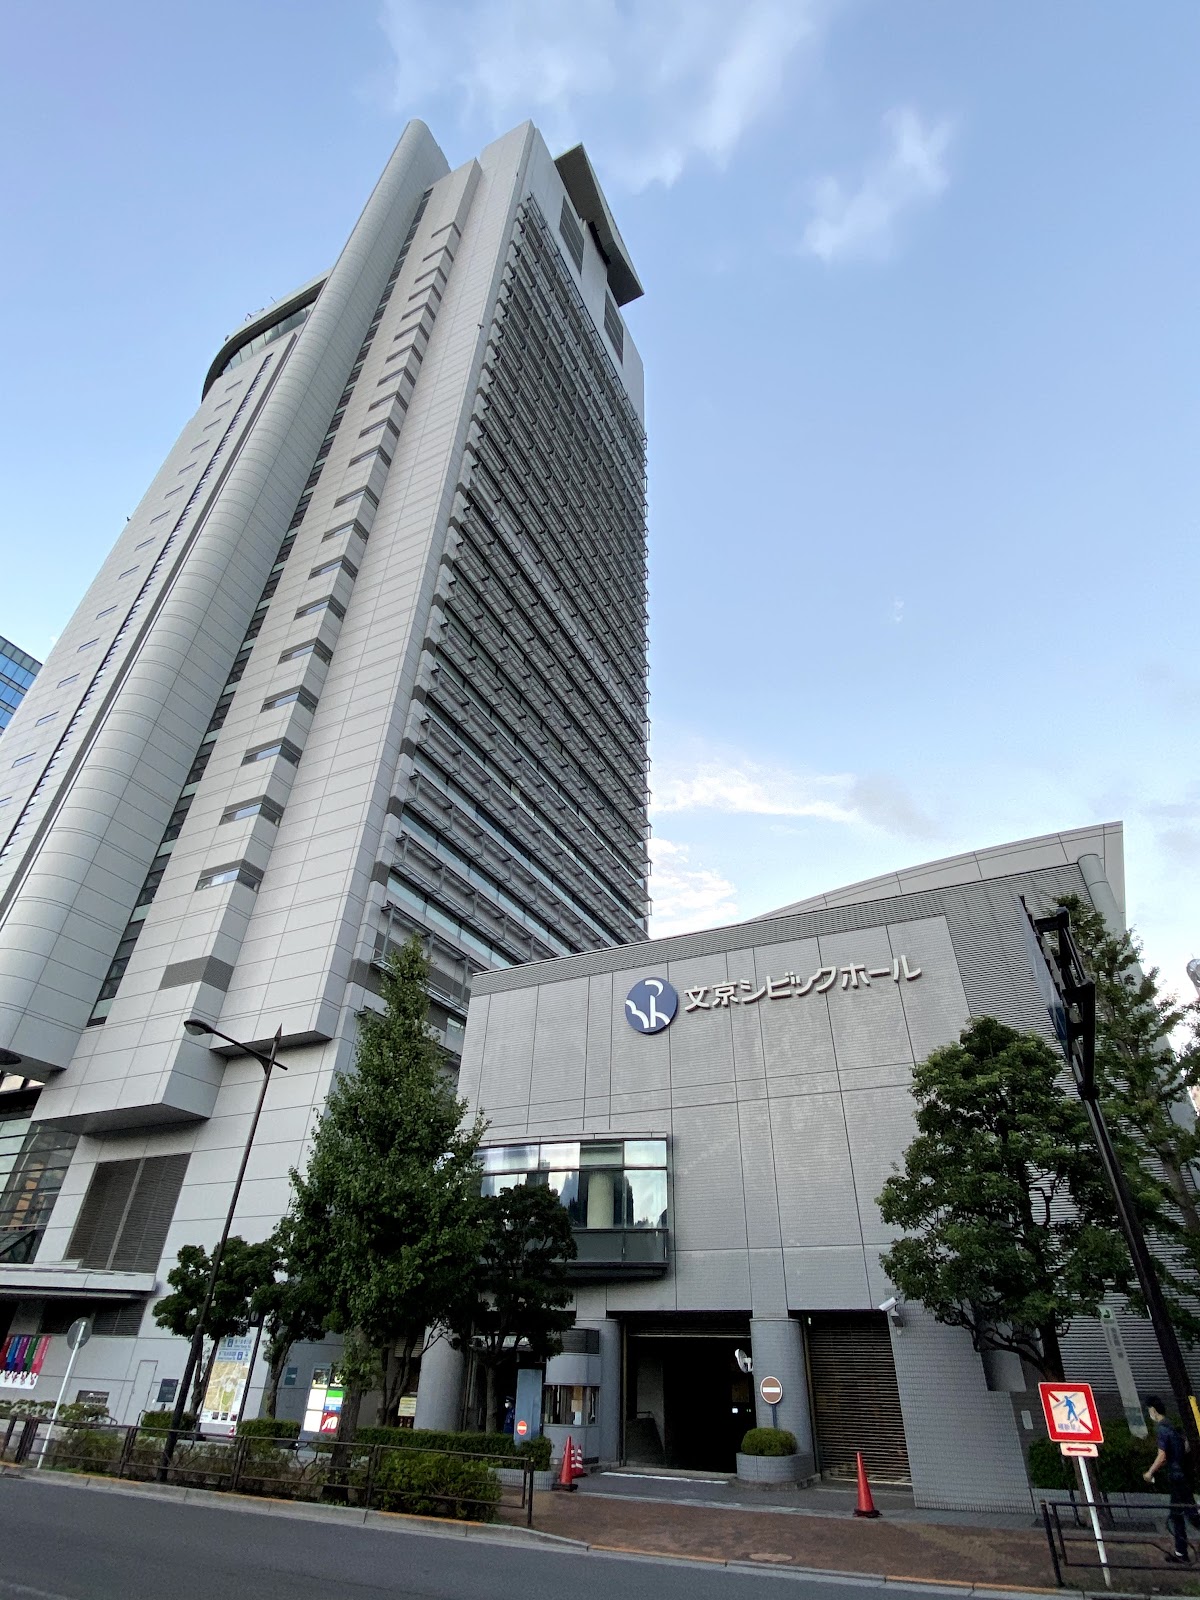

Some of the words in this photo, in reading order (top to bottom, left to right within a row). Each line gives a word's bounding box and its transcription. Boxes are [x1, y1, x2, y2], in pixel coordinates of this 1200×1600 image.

[684, 955, 921, 1012] 文京シビックホール
